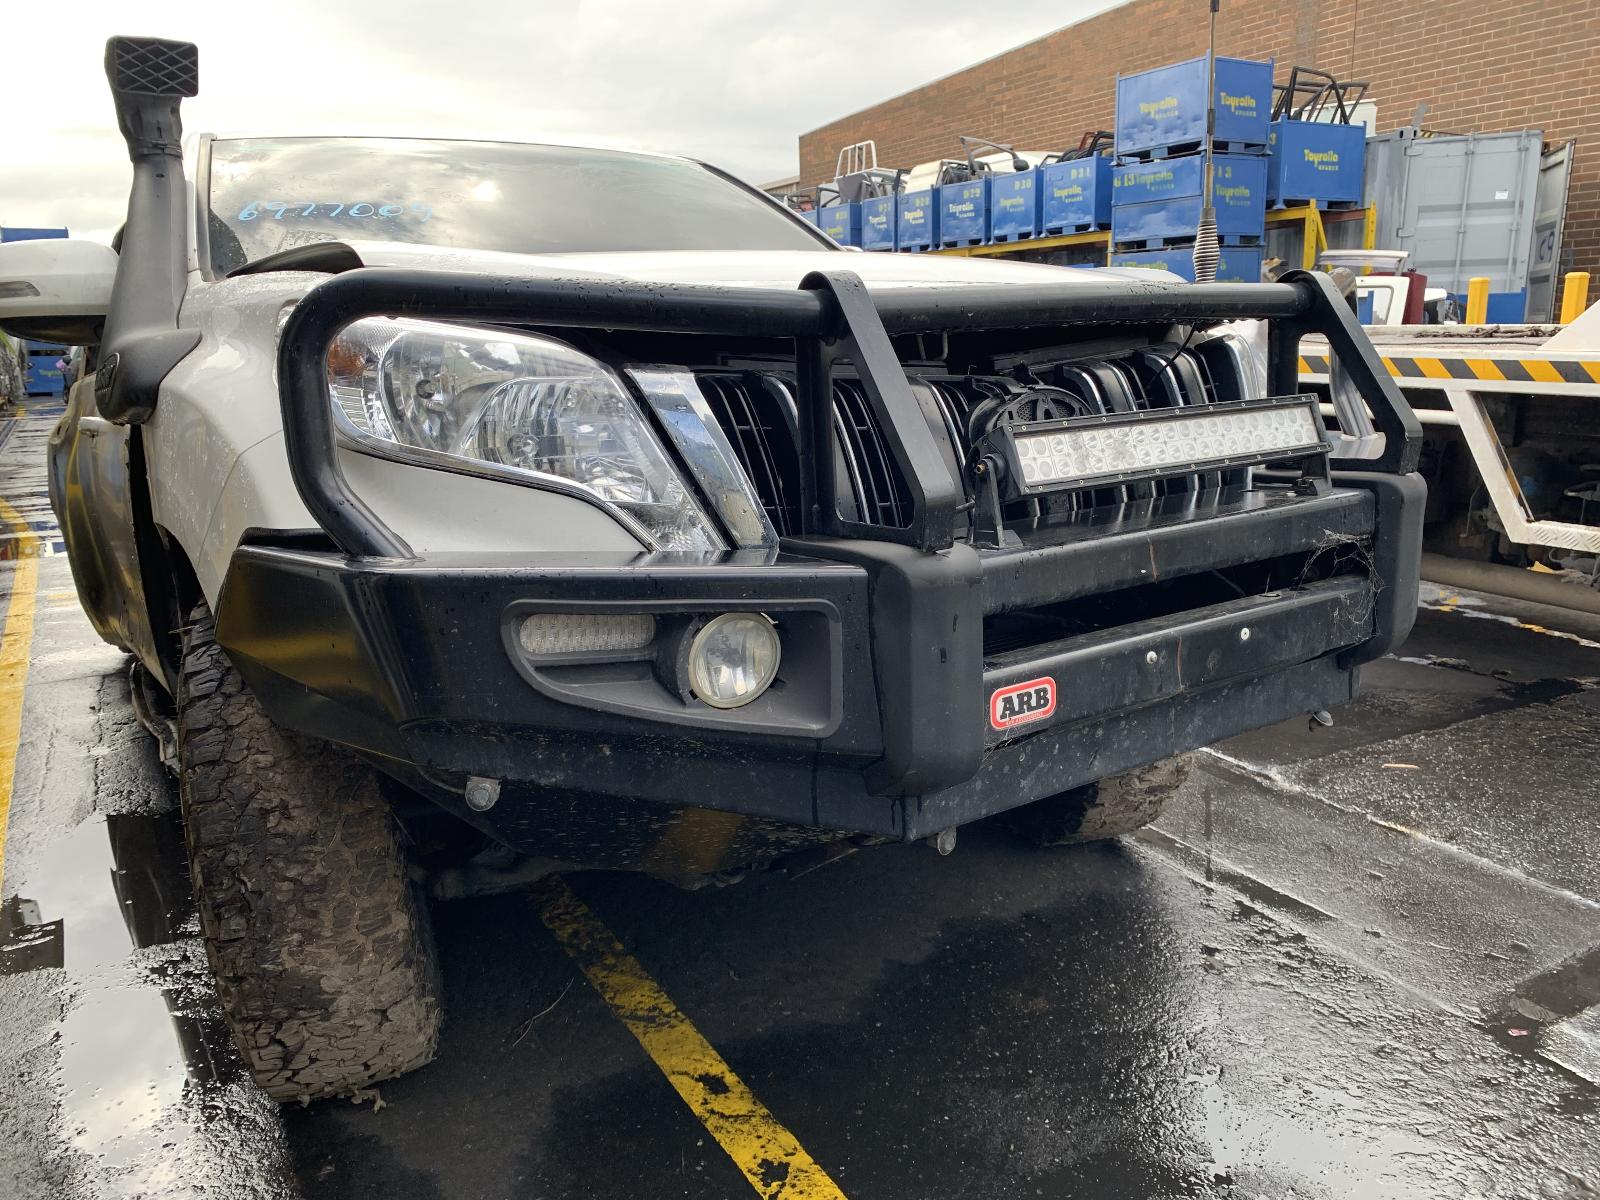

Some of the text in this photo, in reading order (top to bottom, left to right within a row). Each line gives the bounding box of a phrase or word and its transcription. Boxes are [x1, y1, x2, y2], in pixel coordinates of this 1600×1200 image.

[1220, 91, 1256, 112] Toyrolla
[1303, 148, 1338, 168] Toyrolla
[1000, 687, 1049, 720] ARB
